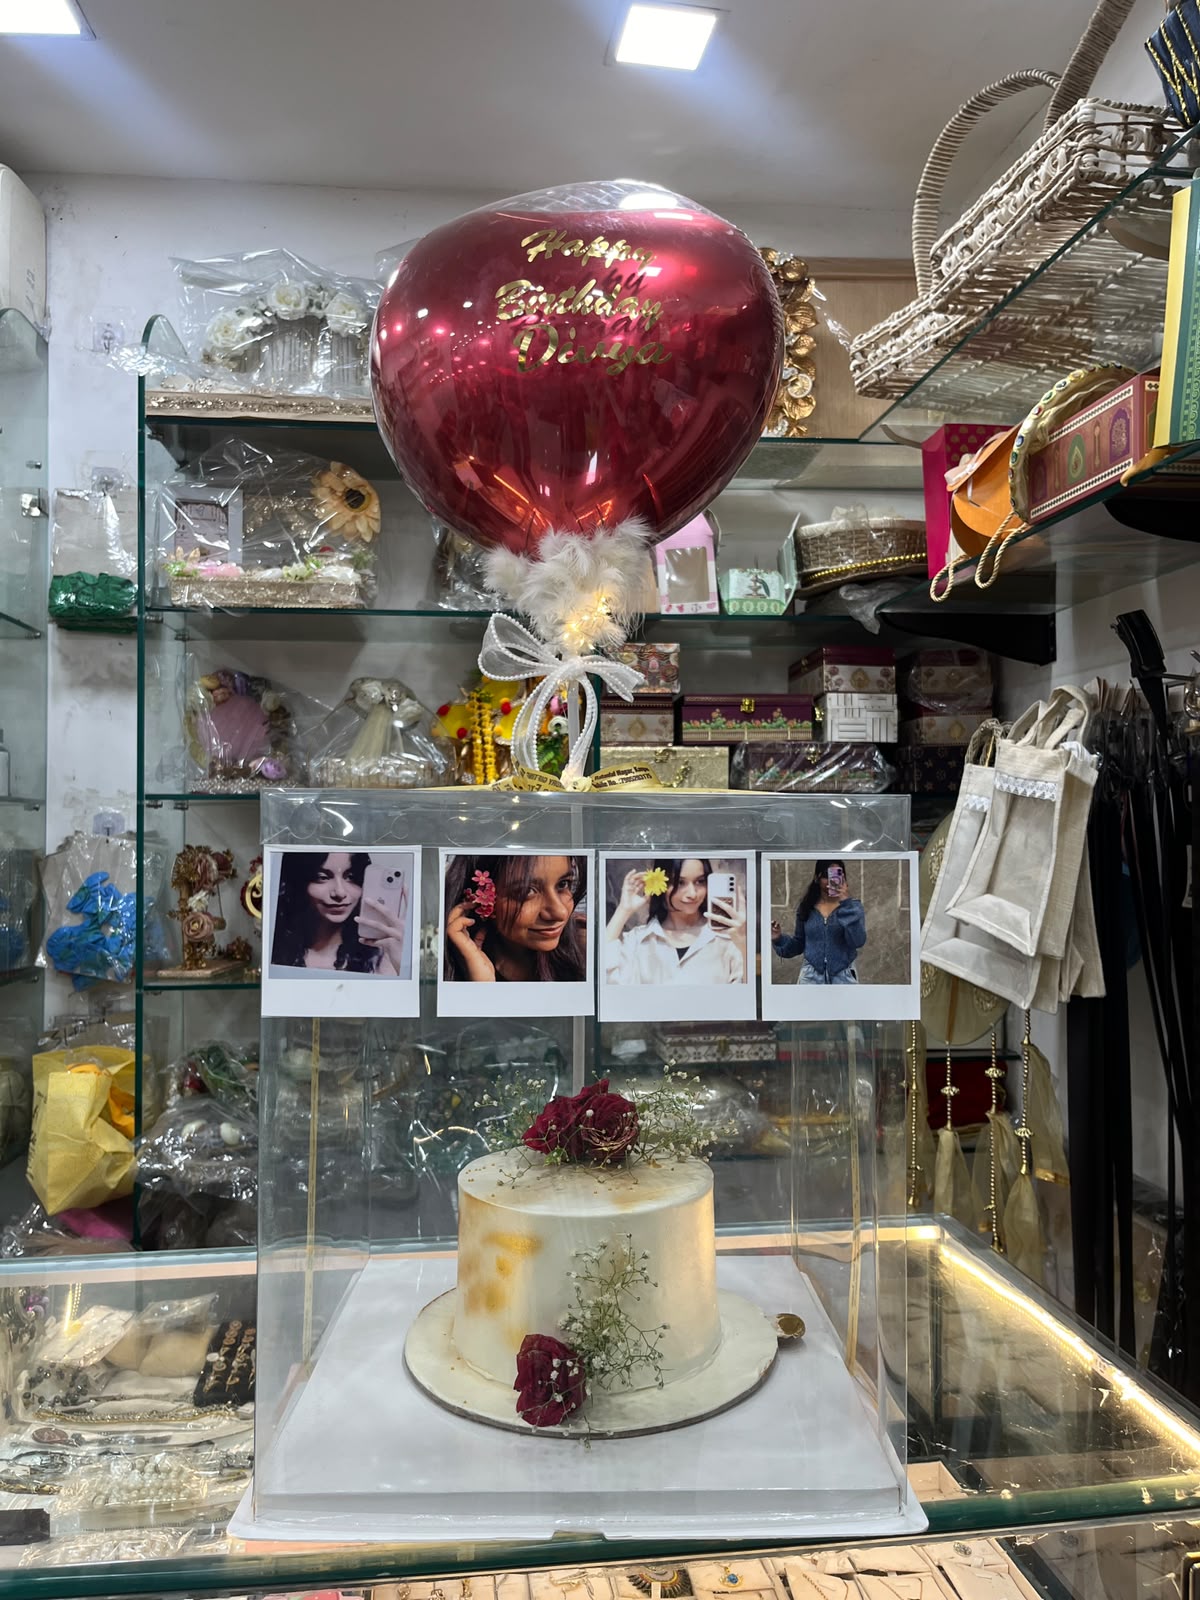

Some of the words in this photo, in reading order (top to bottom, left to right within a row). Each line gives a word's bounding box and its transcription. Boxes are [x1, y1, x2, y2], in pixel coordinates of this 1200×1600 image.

[520, 229, 657, 270] Happy
[496, 278, 664, 331] Birthday
[513, 324, 673, 375] Divya
